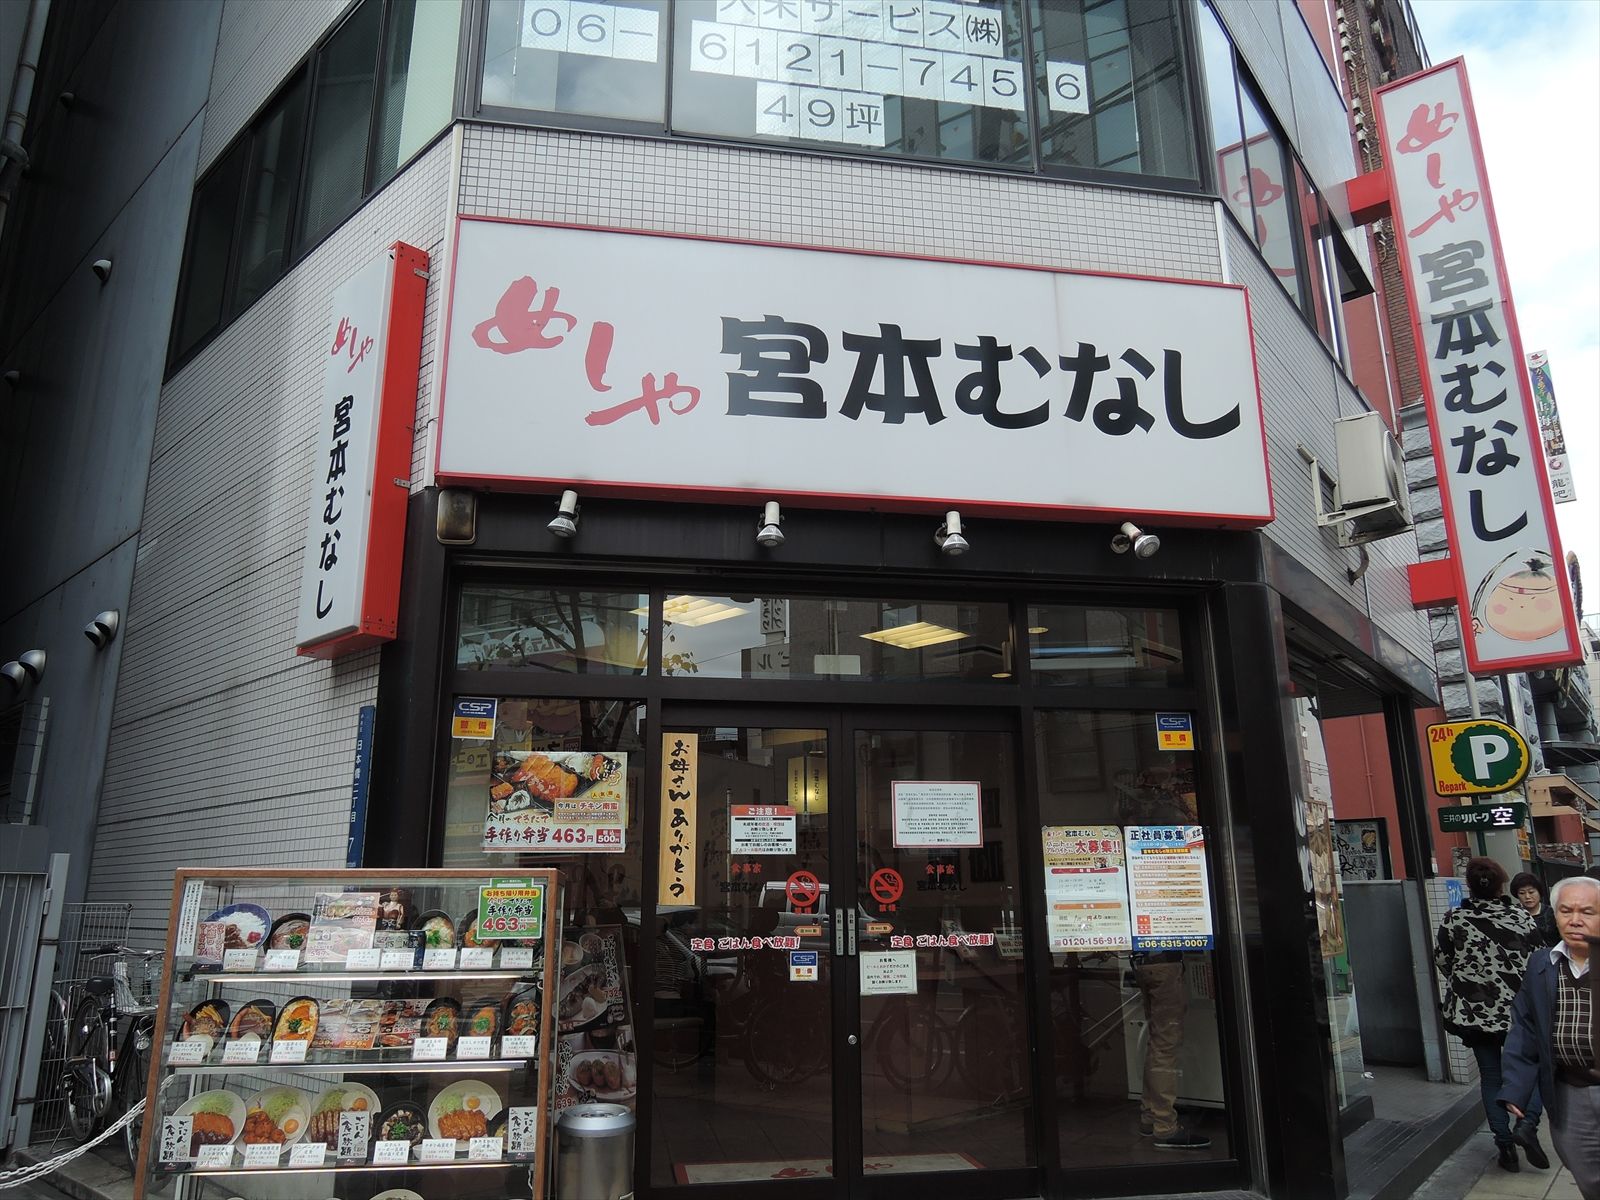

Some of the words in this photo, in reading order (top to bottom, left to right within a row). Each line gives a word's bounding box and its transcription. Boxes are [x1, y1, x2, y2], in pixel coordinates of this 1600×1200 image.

[762, 89, 883, 135] 49坪
[1396, 102, 1479, 238] めしや
[331, 315, 375, 374] めしや
[472, 274, 701, 427] めしや
[720, 312, 1244, 440] 宮本むなし
[1418, 239, 1528, 542] 宮本むなし
[315, 394, 354, 620] 宮本むなし
[458, 702, 492, 712] CSP
[1159, 717, 1187, 726] CSP
[1430, 727, 1454, 743] 24h
[1469, 734, 1509, 780] P
[668, 739, 691, 802] お母さん
[1438, 780, 1467, 793] Repark
[1490, 806, 1516, 826] 空
[484, 826, 550, 843] 手作り弁当
[552, 828, 594, 844] 463円
[1130, 829, 1185, 841] 正社員募集
[668, 807, 692, 899] ありがとう
[487, 905, 533, 916] 手作り弁当
[690, 938, 716, 951] 定食
[717, 936, 800, 950] ごはん食べ放題!
[890, 935, 914, 948] 定食
[915, 933, 994, 948] ごはん食べ放題!
